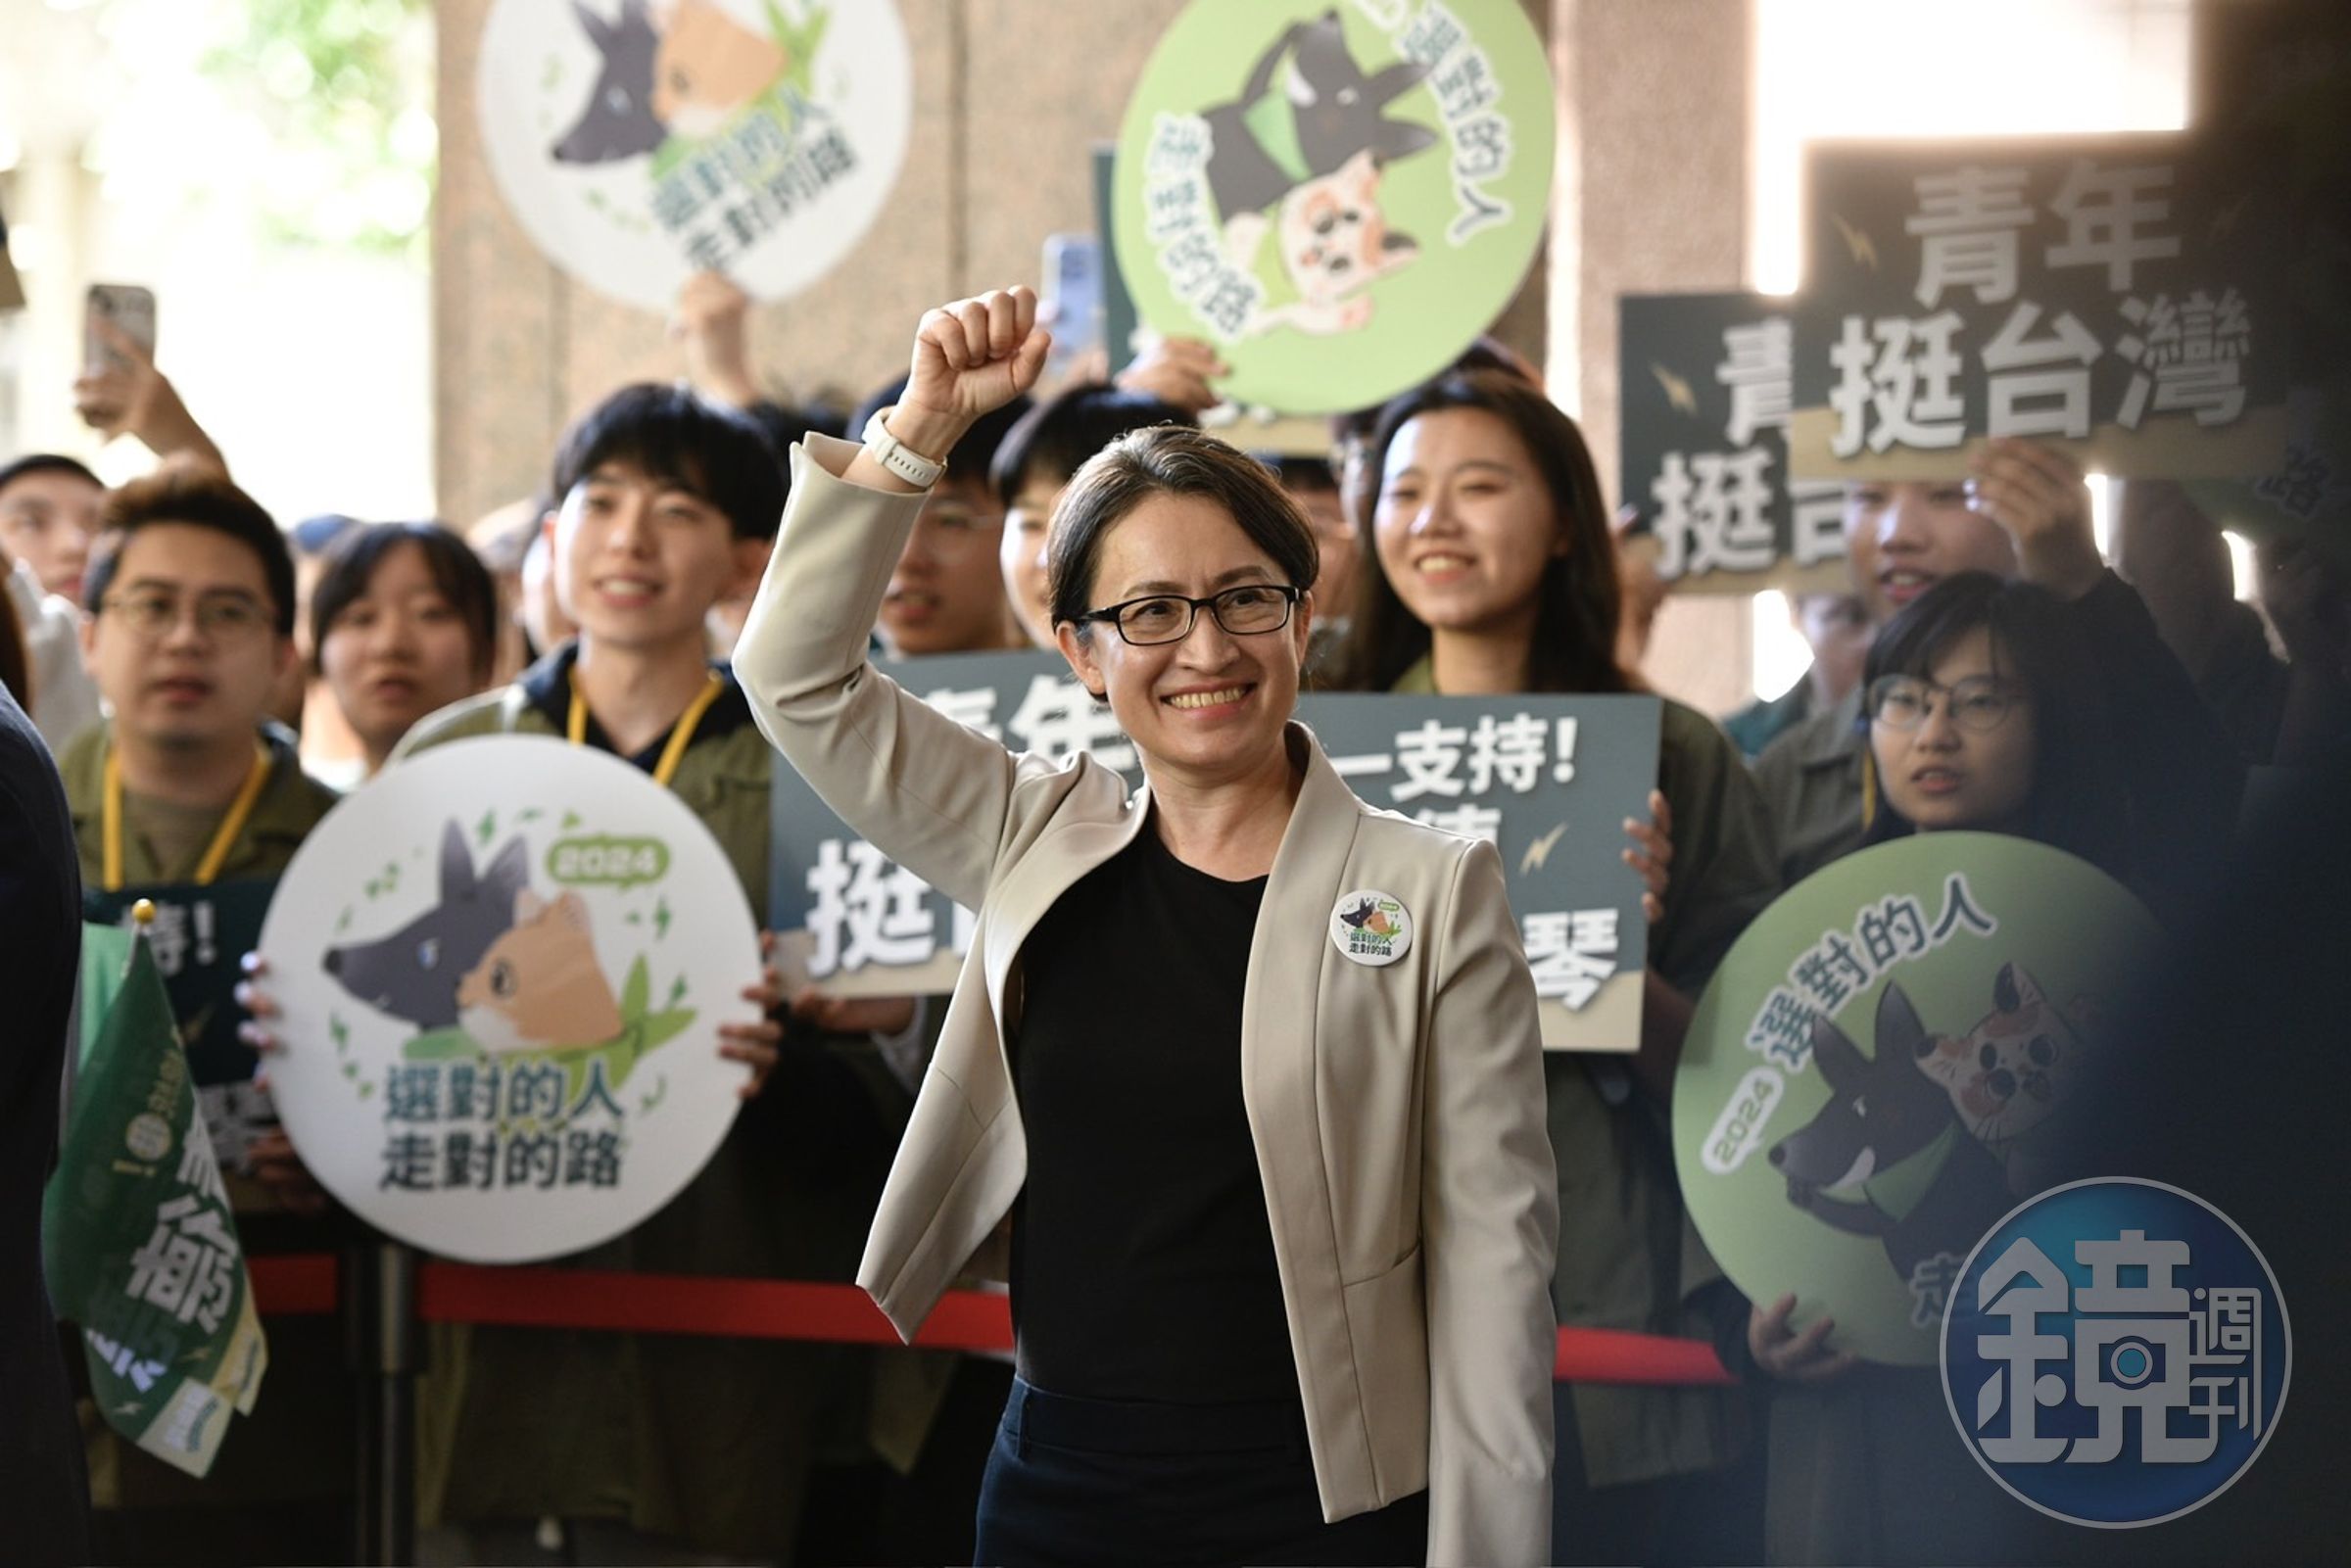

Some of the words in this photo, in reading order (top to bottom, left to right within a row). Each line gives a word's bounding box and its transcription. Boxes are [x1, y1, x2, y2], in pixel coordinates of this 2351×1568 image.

[1904, 161, 2183, 309] 青年
[1828, 290, 2253, 461] 挺台灣
[555, 845, 659, 876] 2024
[1521, 907, 1620, 1013] 琴
[1751, 878, 1994, 1067] 選對的人
[384, 1060, 625, 1124] 選對的人
[1714, 1080, 1774, 1164] 2024
[378, 1129, 625, 1192] 走對的路
